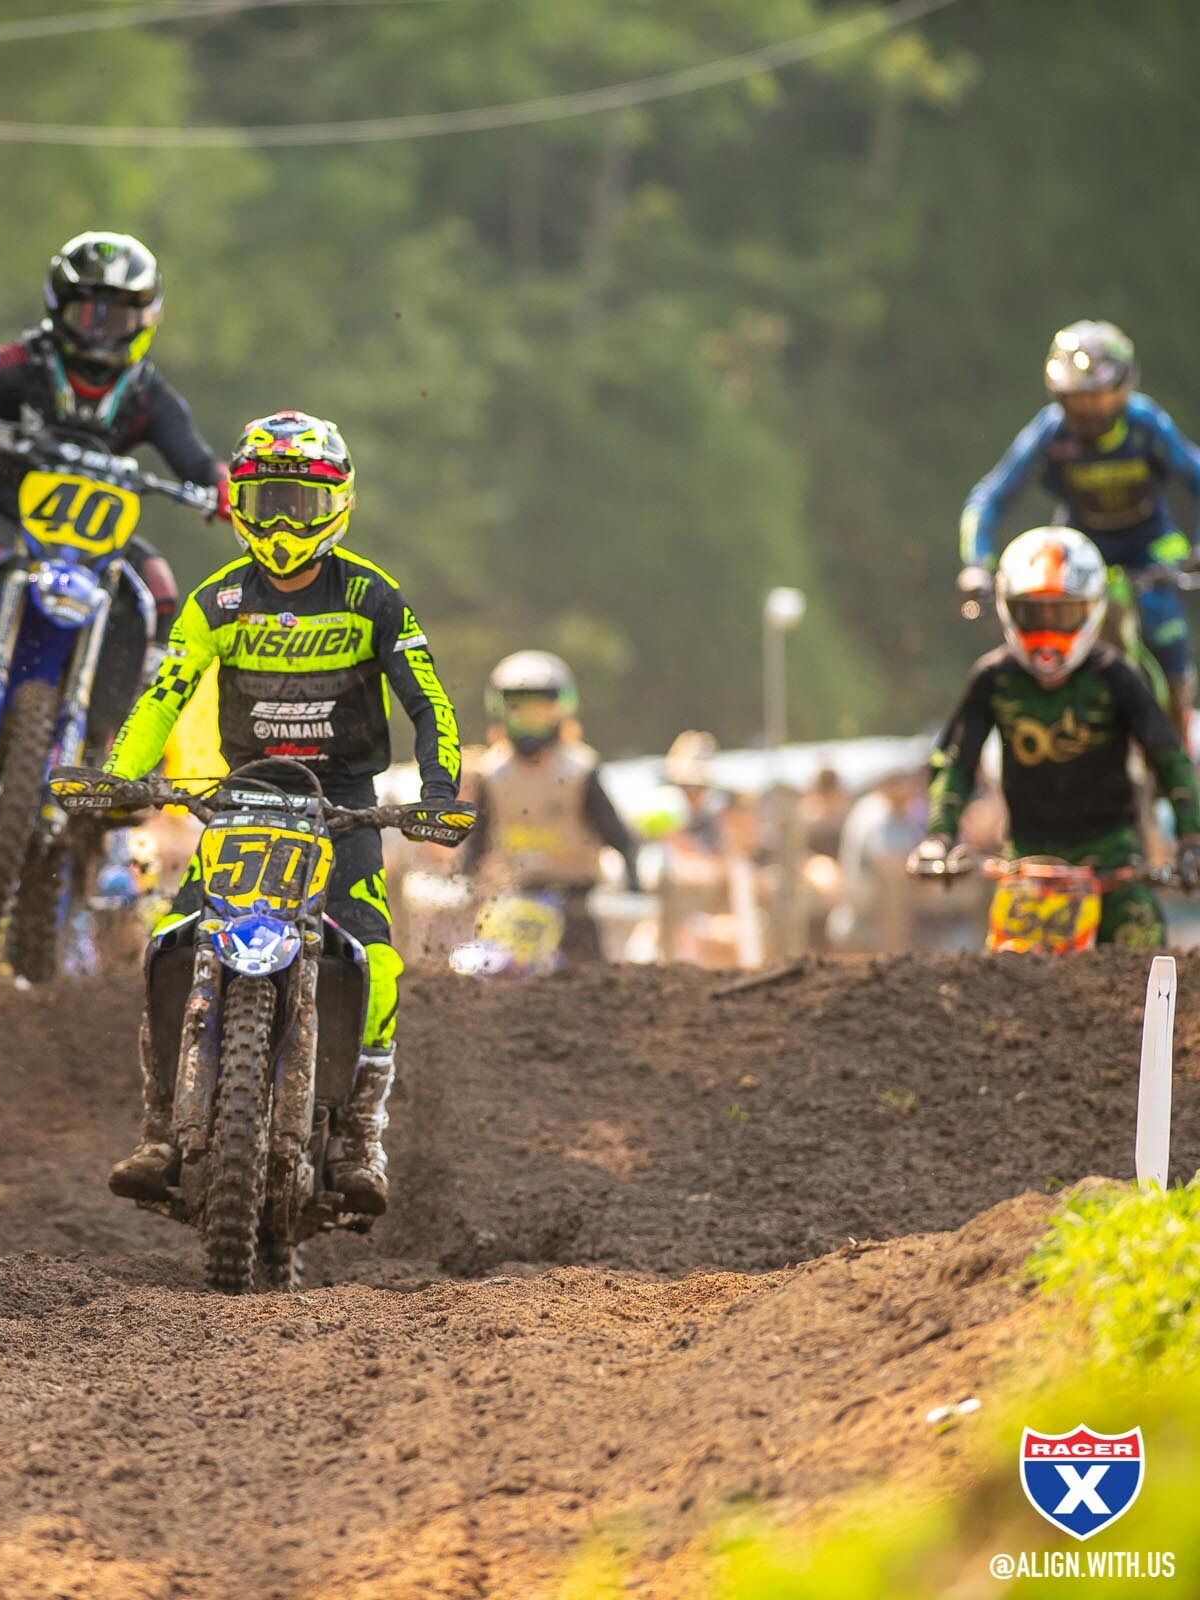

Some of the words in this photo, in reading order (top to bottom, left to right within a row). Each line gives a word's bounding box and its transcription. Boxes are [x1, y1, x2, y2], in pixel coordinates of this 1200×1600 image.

[257, 463, 309, 474] REYES
[28, 482, 125, 542] 40
[270, 721, 335, 738] YAMAHA
[208, 833, 322, 898] 50
